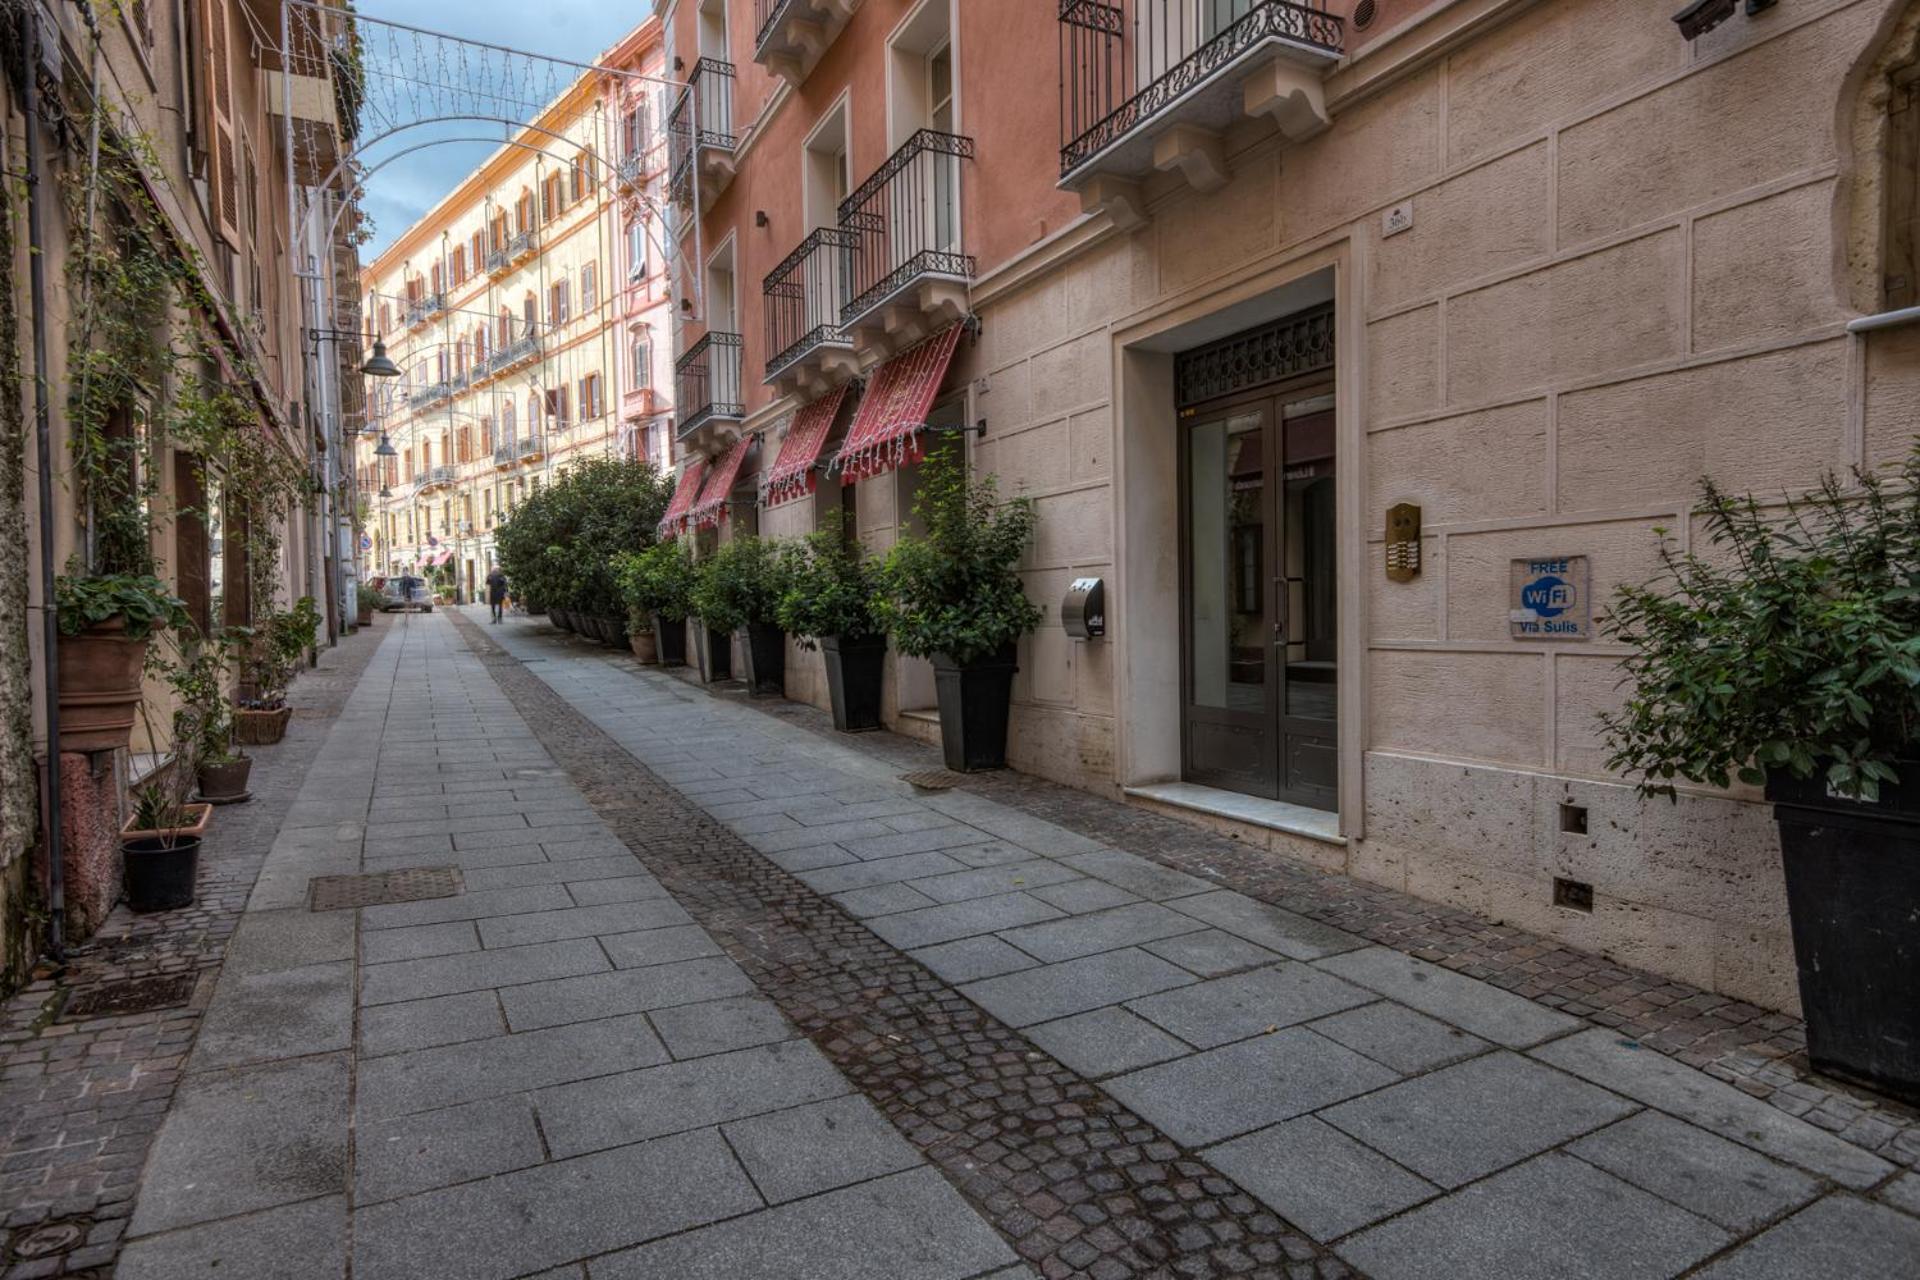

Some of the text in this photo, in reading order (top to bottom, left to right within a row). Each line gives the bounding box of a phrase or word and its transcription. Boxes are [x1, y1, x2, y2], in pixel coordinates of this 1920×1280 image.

[1530, 559, 1568, 574] FREE
[1520, 620, 1578, 633] Via Sulis
